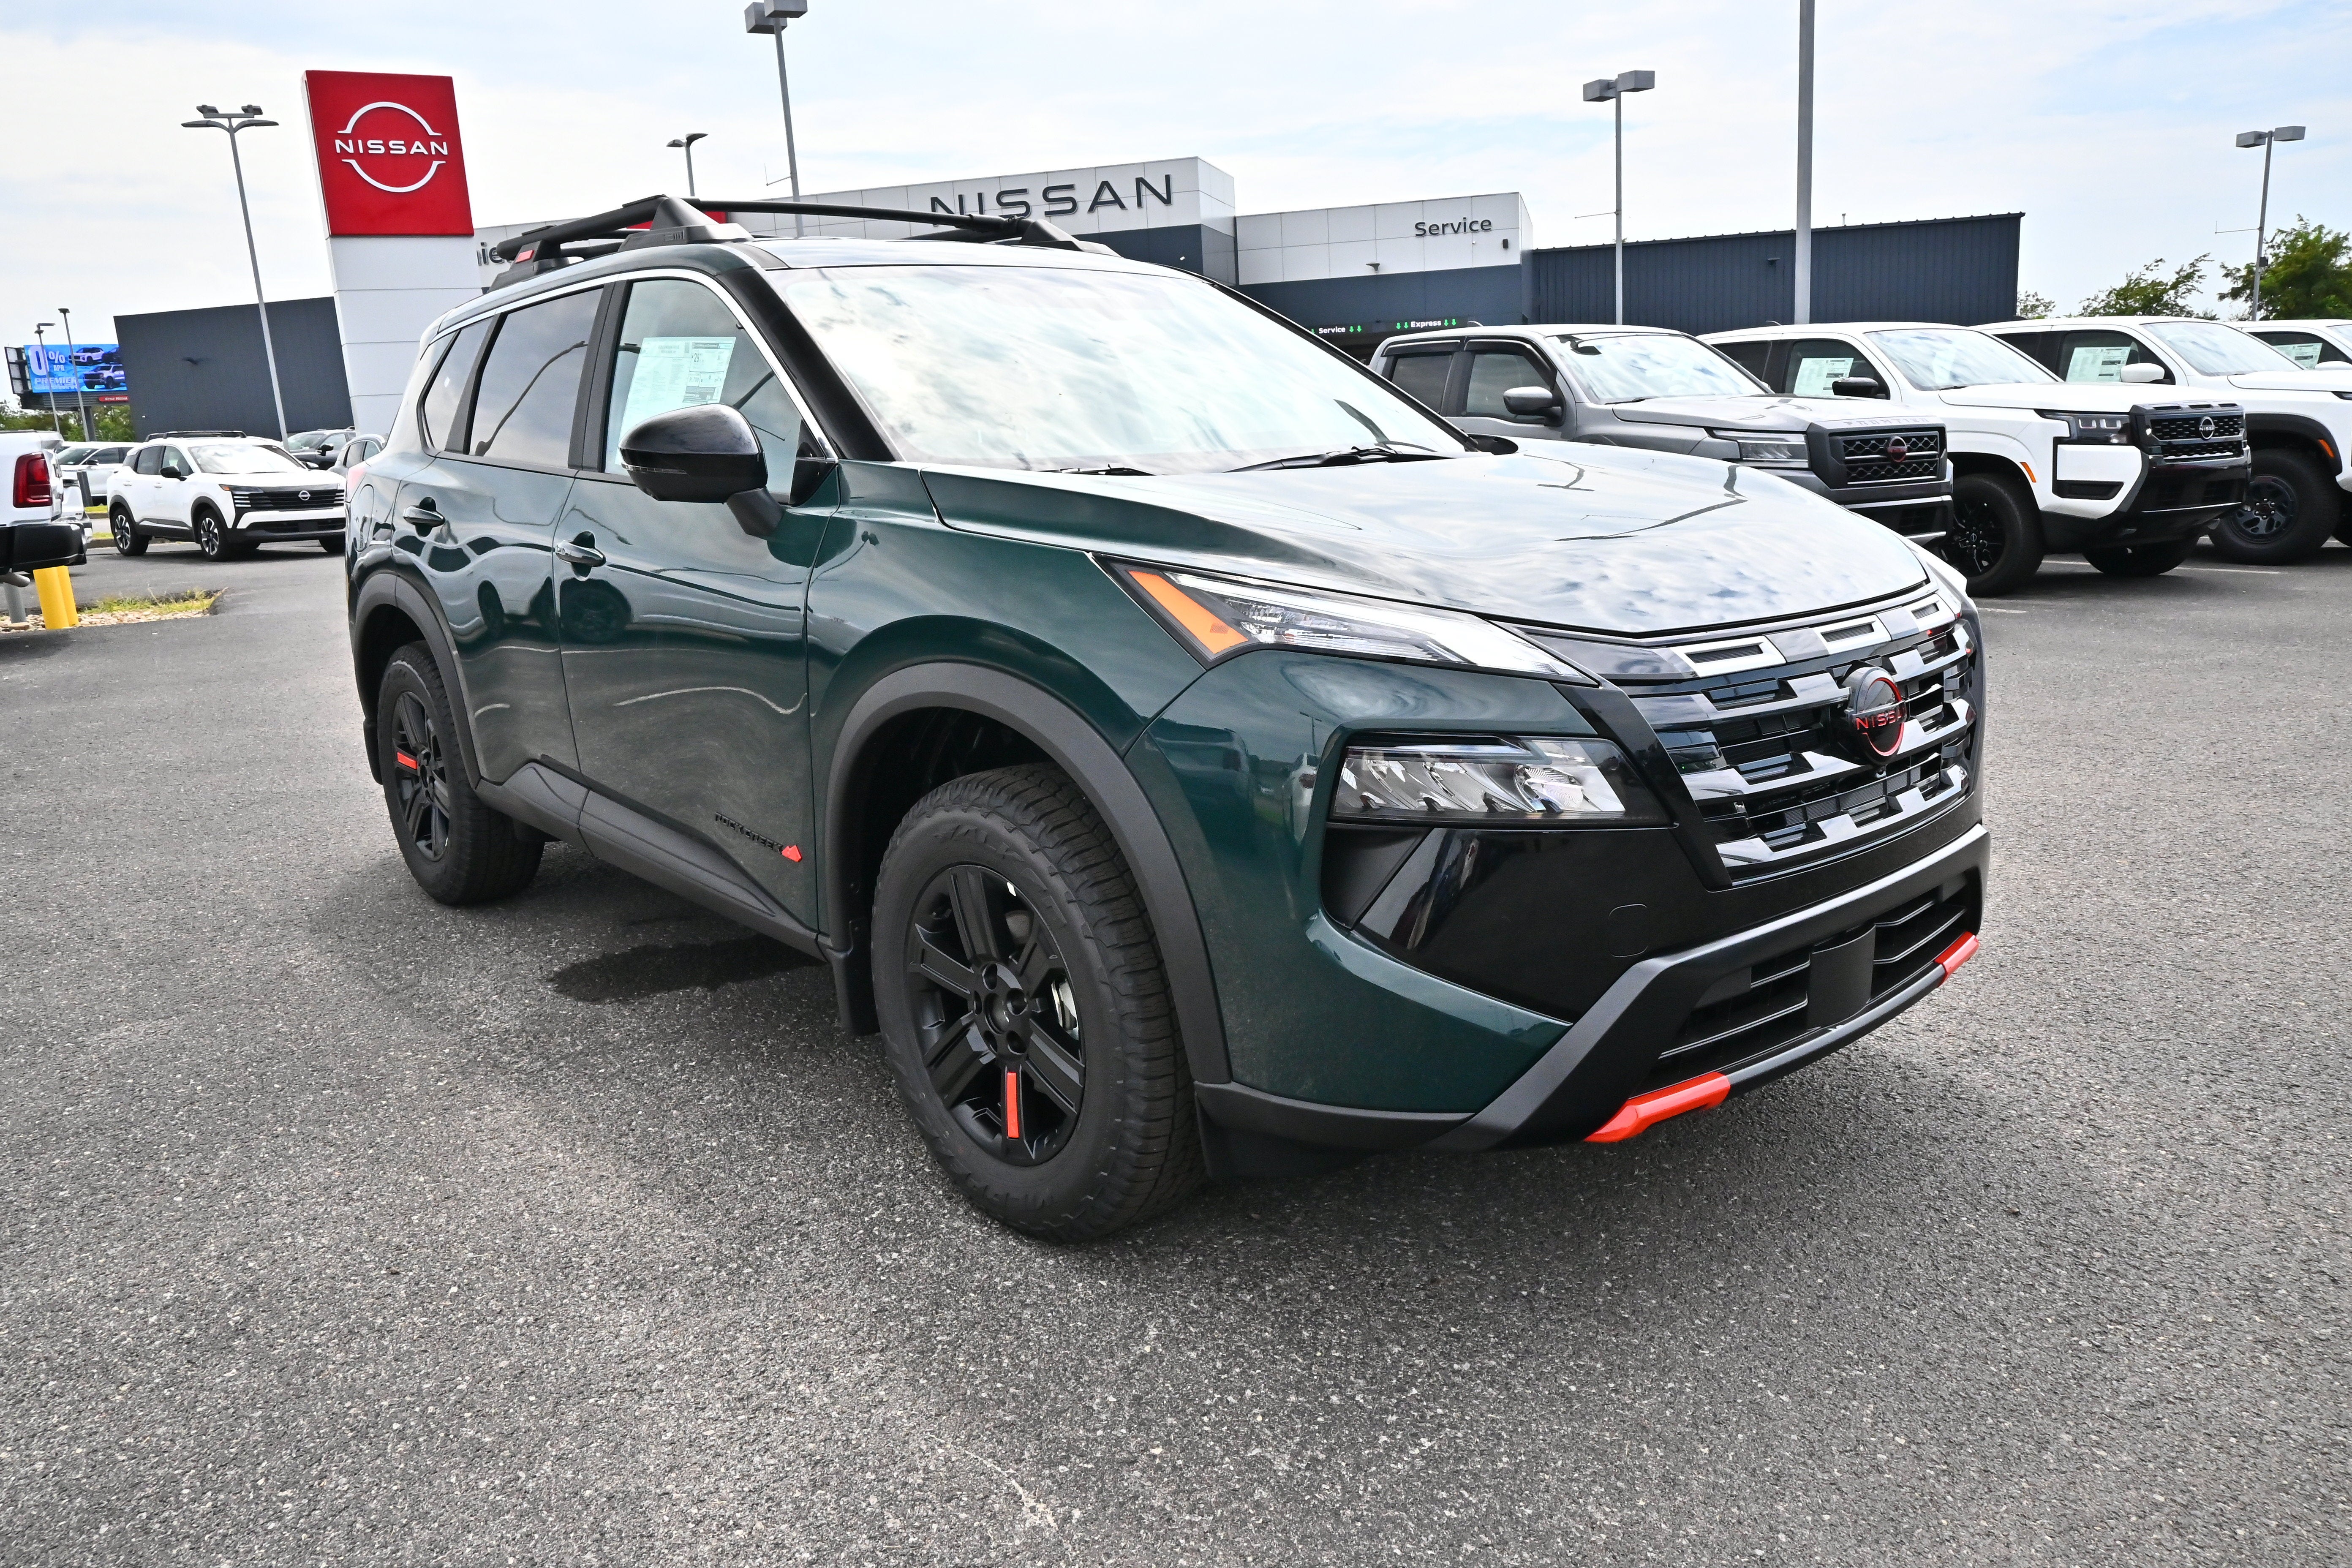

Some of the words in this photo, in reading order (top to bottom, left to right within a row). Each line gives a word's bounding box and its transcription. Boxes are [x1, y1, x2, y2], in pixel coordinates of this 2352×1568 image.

[335, 139, 448, 155] NISSAN
[930, 174, 1163, 226] NISSAN
[1415, 217, 1492, 237] Service
[1318, 326, 1346, 334] Service
[1410, 320, 1441, 328] Express
[1843, 418, 1930, 426] FRONTIER
[715, 812, 745, 835] ROCK
[744, 828, 784, 854] CREEK
